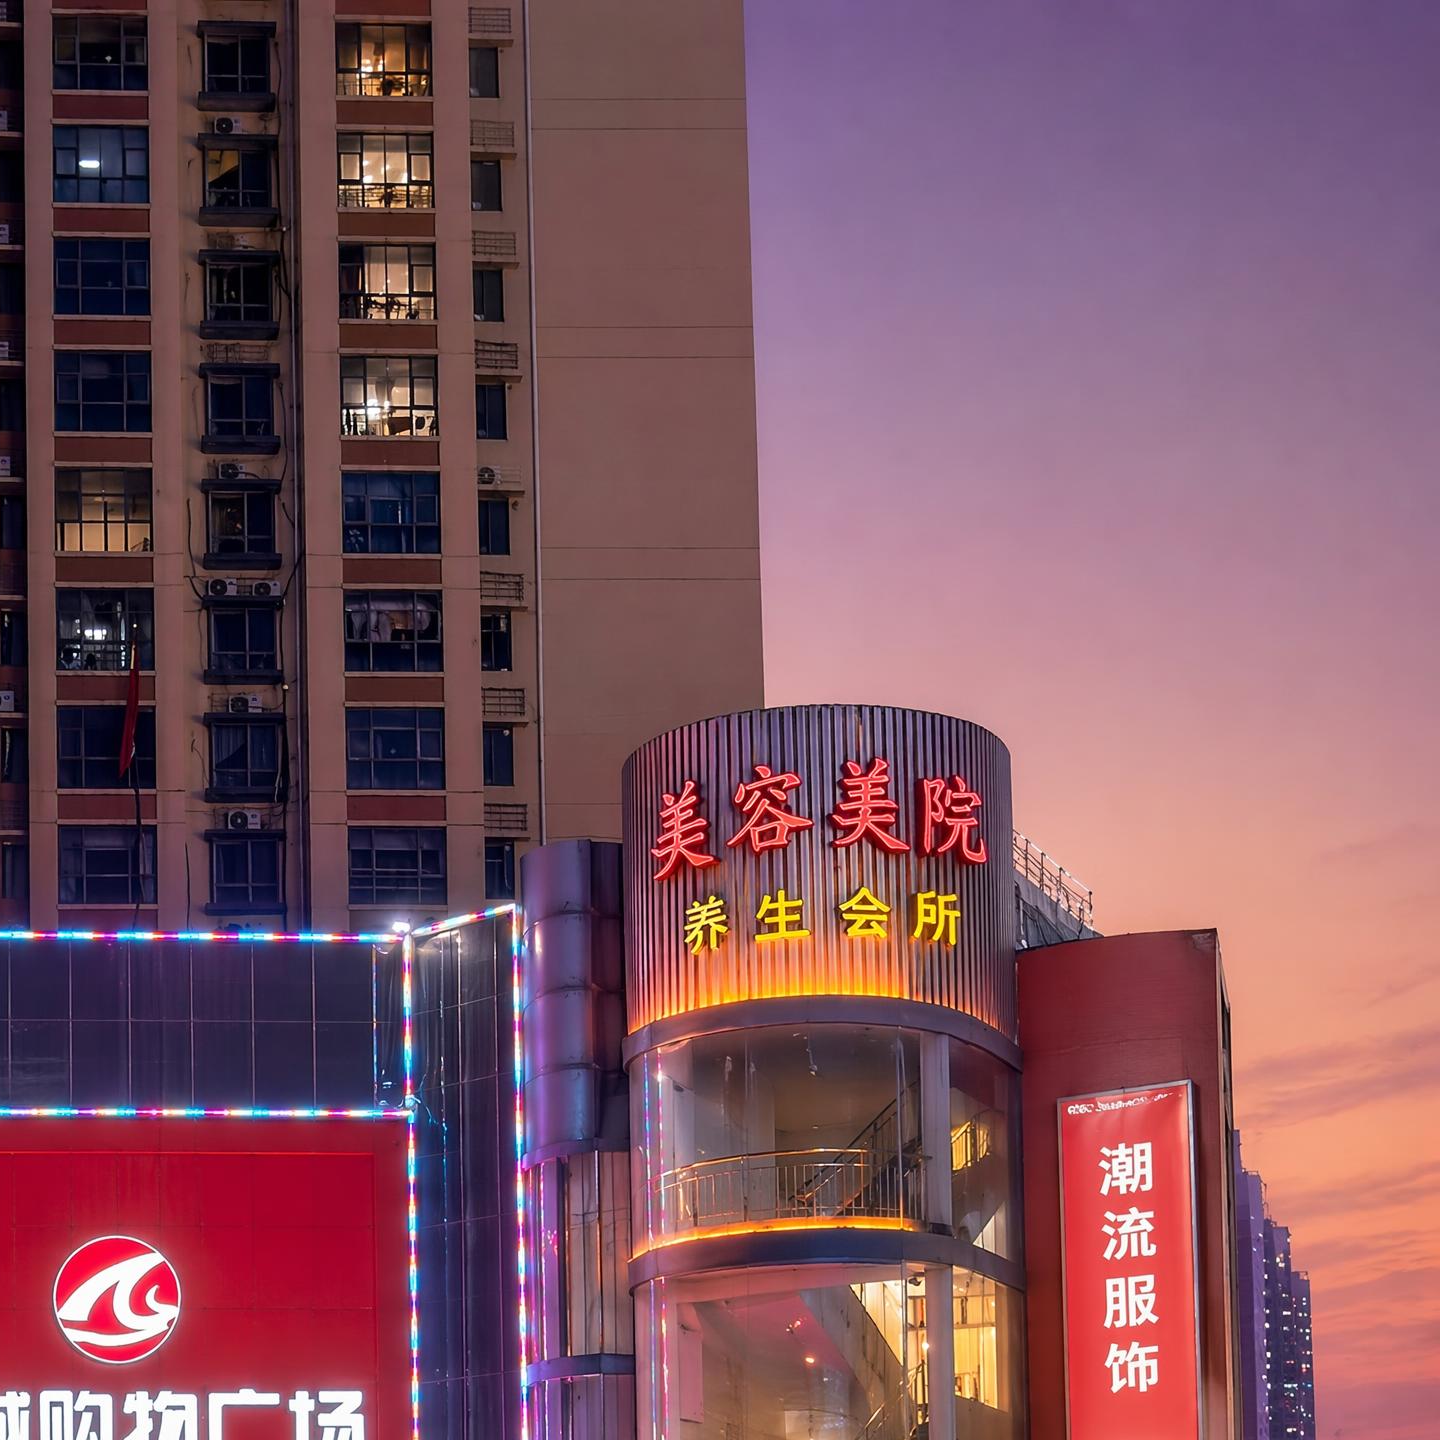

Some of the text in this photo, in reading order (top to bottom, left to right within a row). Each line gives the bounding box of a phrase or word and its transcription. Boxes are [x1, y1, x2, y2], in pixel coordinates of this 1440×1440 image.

[651, 756, 988, 881] 美容美院
[684, 886, 961, 955] 养生会所
[1098, 1142, 1159, 1394] 潮流服饰
